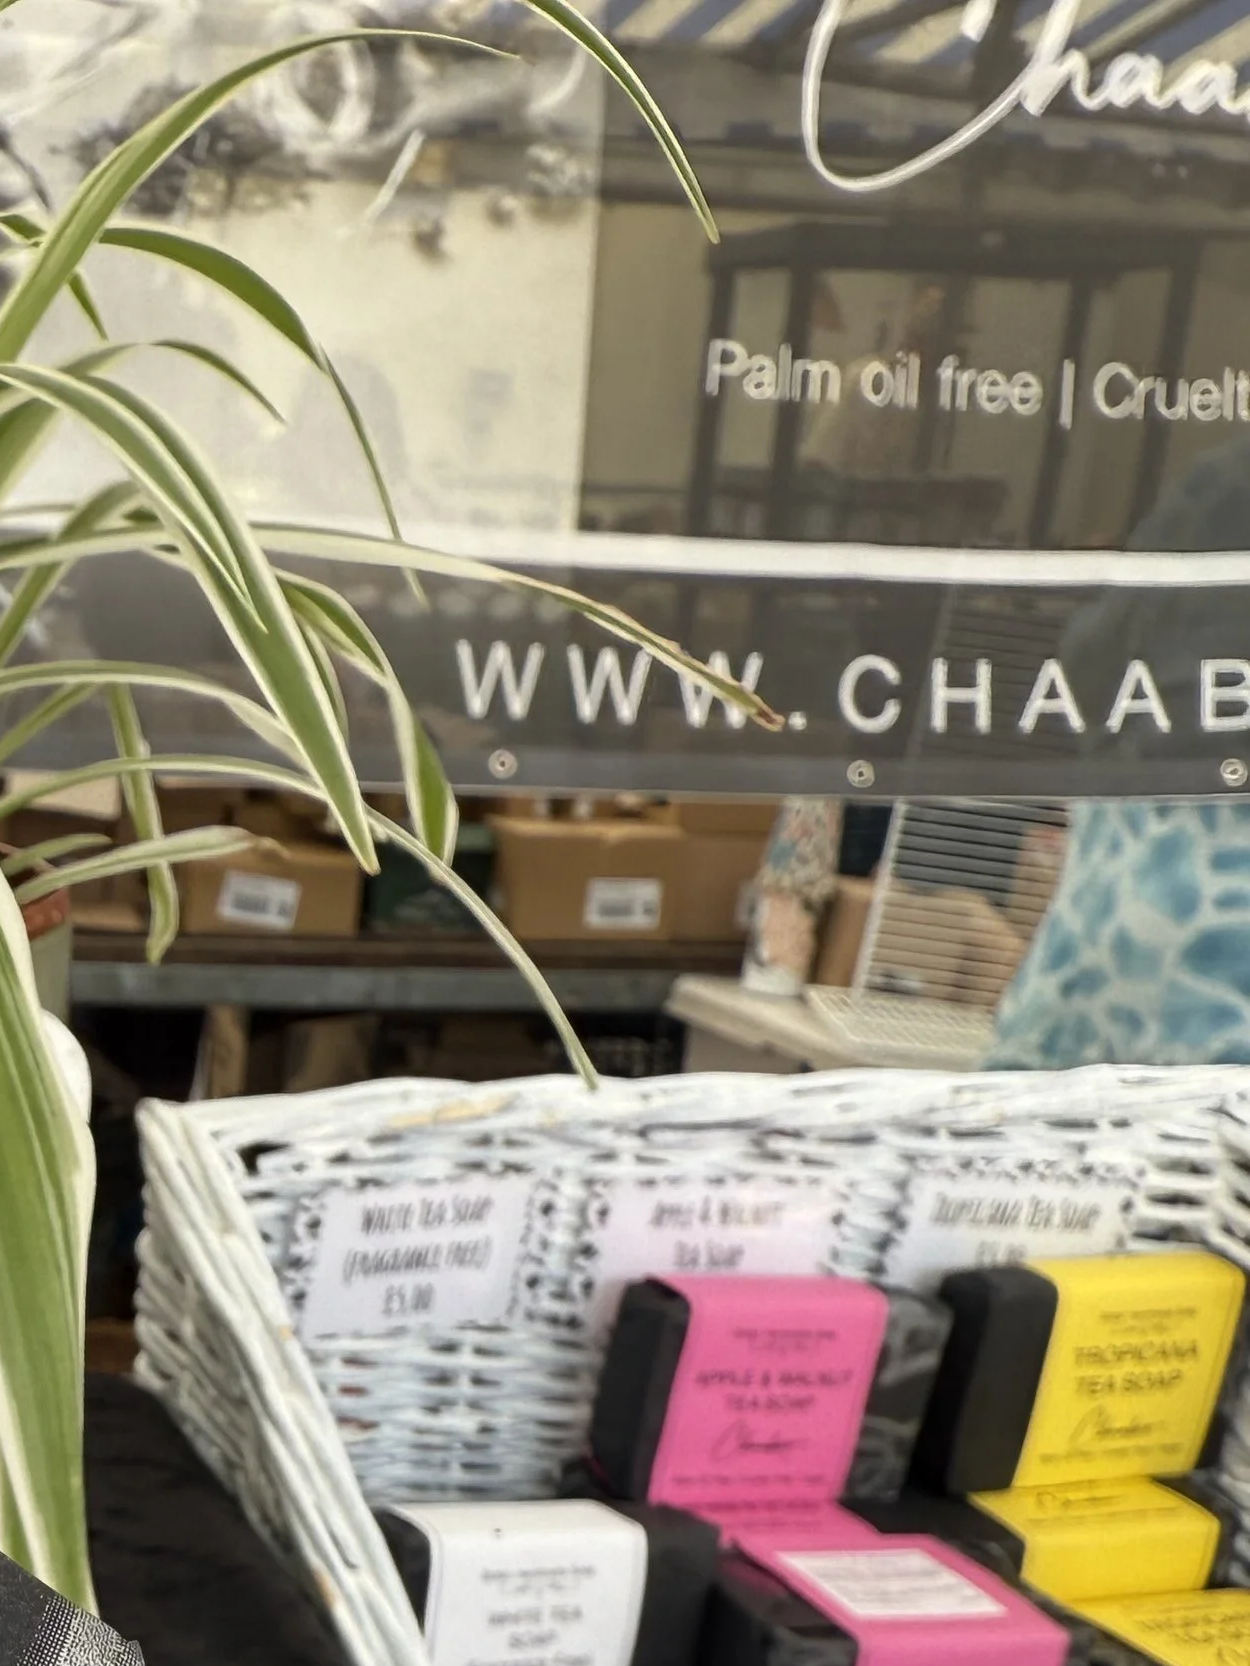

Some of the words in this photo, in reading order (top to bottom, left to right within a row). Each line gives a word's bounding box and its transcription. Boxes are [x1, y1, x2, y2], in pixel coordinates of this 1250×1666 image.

[705, 338, 841, 403] Palm
[860, 350, 921, 409] oil
[938, 353, 1044, 415] free
